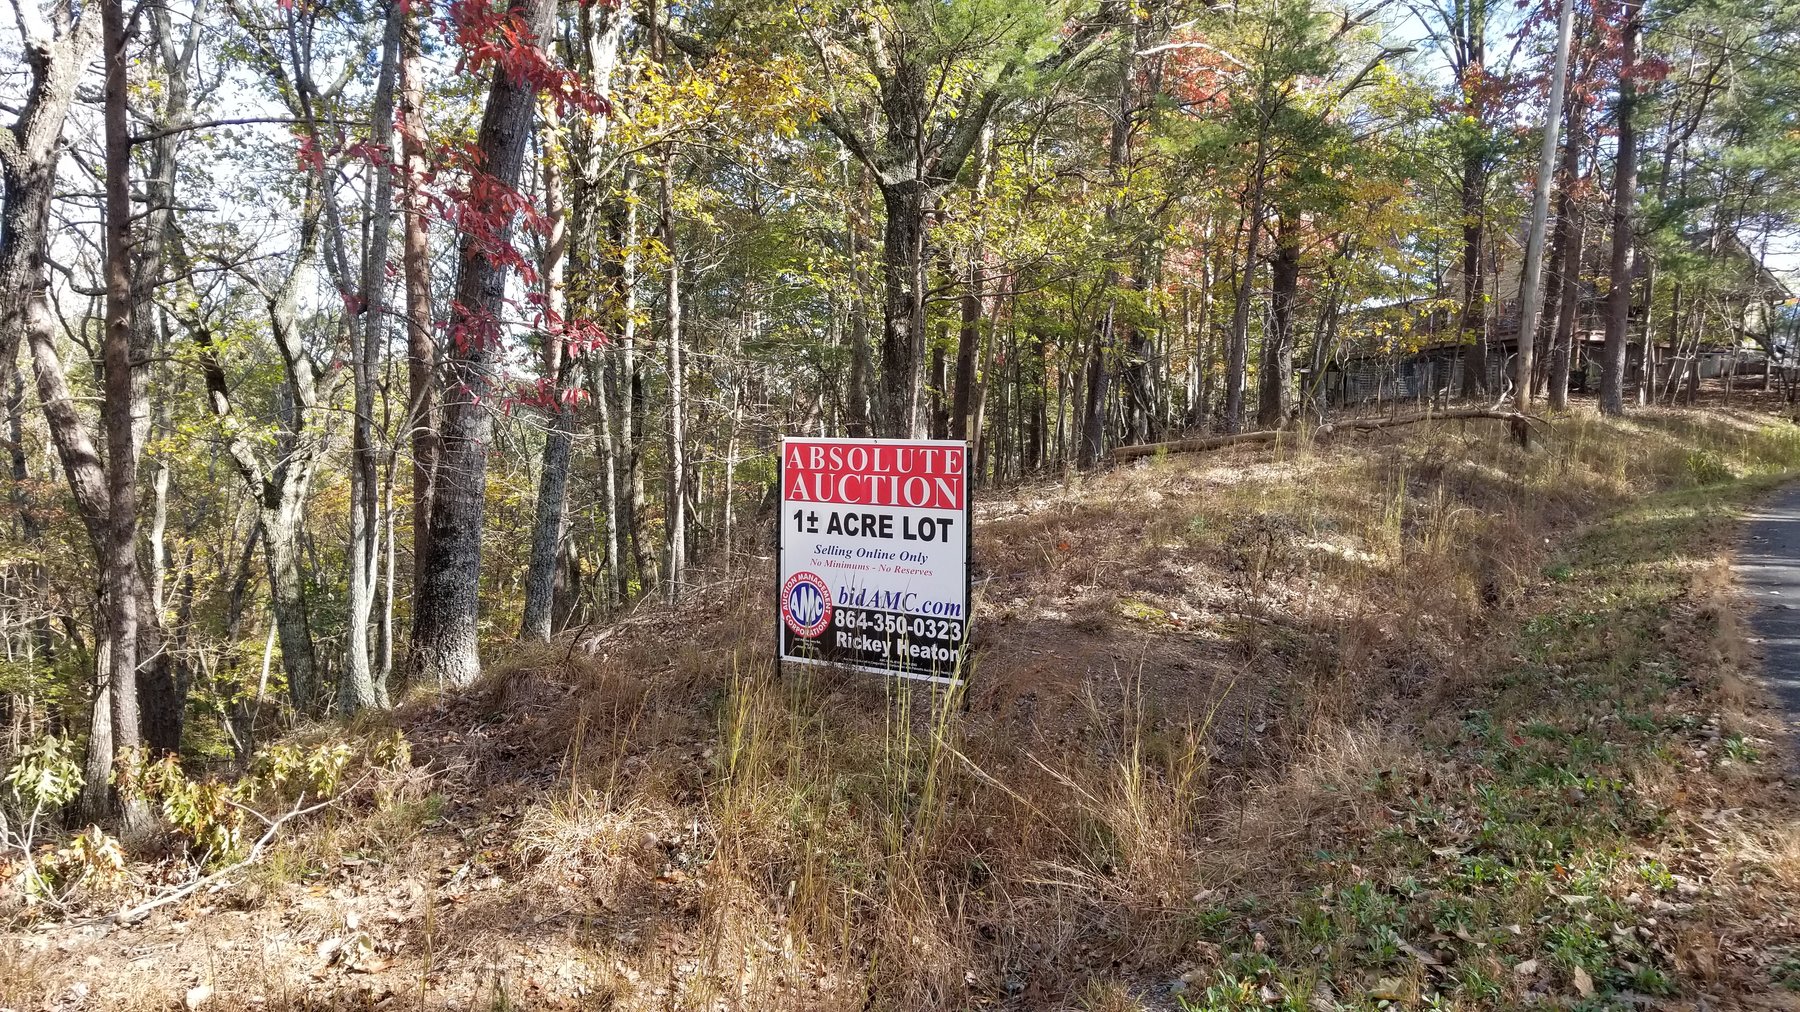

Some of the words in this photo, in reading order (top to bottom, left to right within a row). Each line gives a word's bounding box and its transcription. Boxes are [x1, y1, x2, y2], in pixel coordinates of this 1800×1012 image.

[786, 446, 963, 475] ABSOLUTE
[788, 472, 959, 508] AUCTION
[793, 510, 819, 533] 1±
[827, 512, 893, 539] ACRE
[903, 516, 954, 543] LOT
[810, 558, 822, 567] No
[825, 560, 870, 571] Minimums
[879, 564, 892, 573] No
[894, 565, 934, 577] Reserves
[814, 544, 852, 560] Selling
[856, 547, 896, 561] Online
[899, 551, 929, 565] Only
[782, 577, 798, 611] AUCTION
[798, 572, 831, 615] MANAGEMENT
[790, 586, 823, 626] AMC
[838, 586, 961, 617] bidAMC.com
[834, 609, 962, 641] 864-350-0323
[836, 631, 892, 657] Rickey
[896, 638, 960, 662] Heaton
